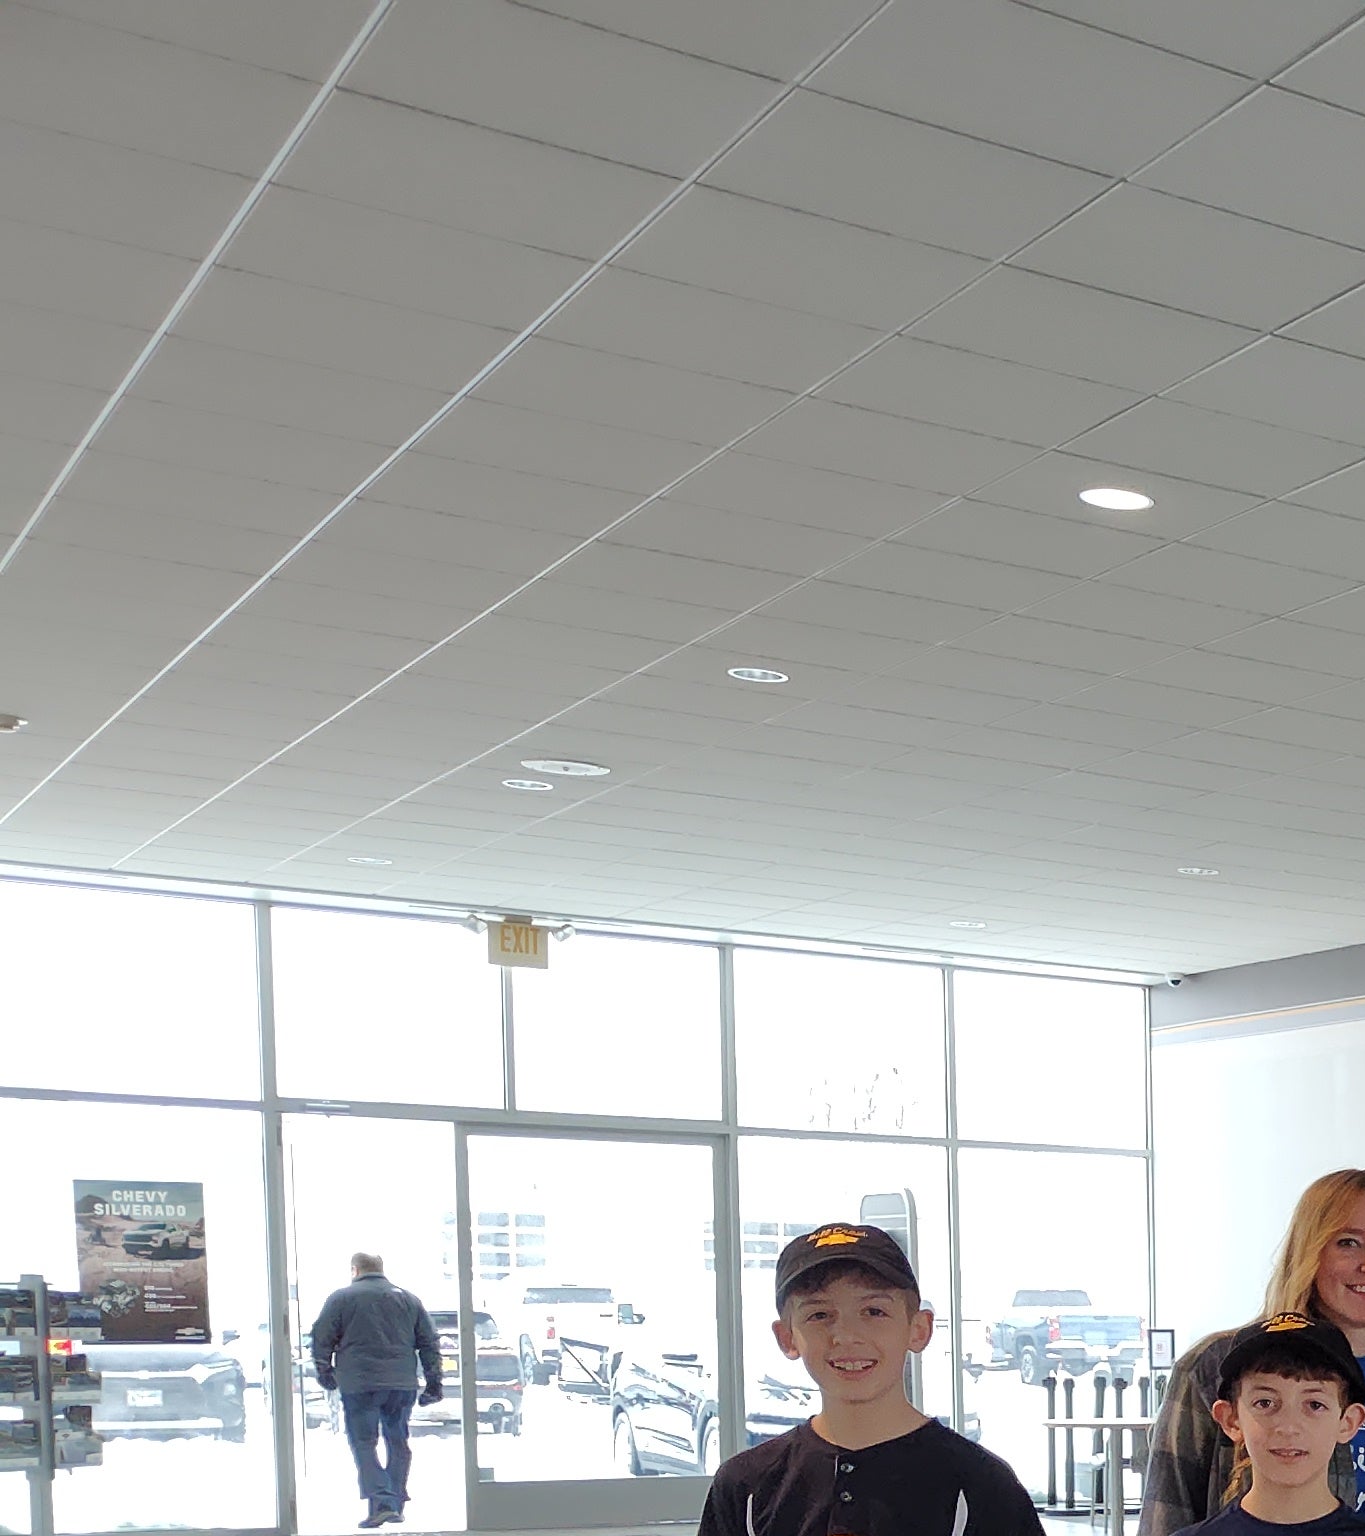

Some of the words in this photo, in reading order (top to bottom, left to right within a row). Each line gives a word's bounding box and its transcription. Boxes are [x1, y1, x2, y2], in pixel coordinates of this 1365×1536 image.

[501, 924, 540, 955] EXIT
[112, 1190, 168, 1203] CHEVY
[94, 1203, 187, 1217] SILVERADO
